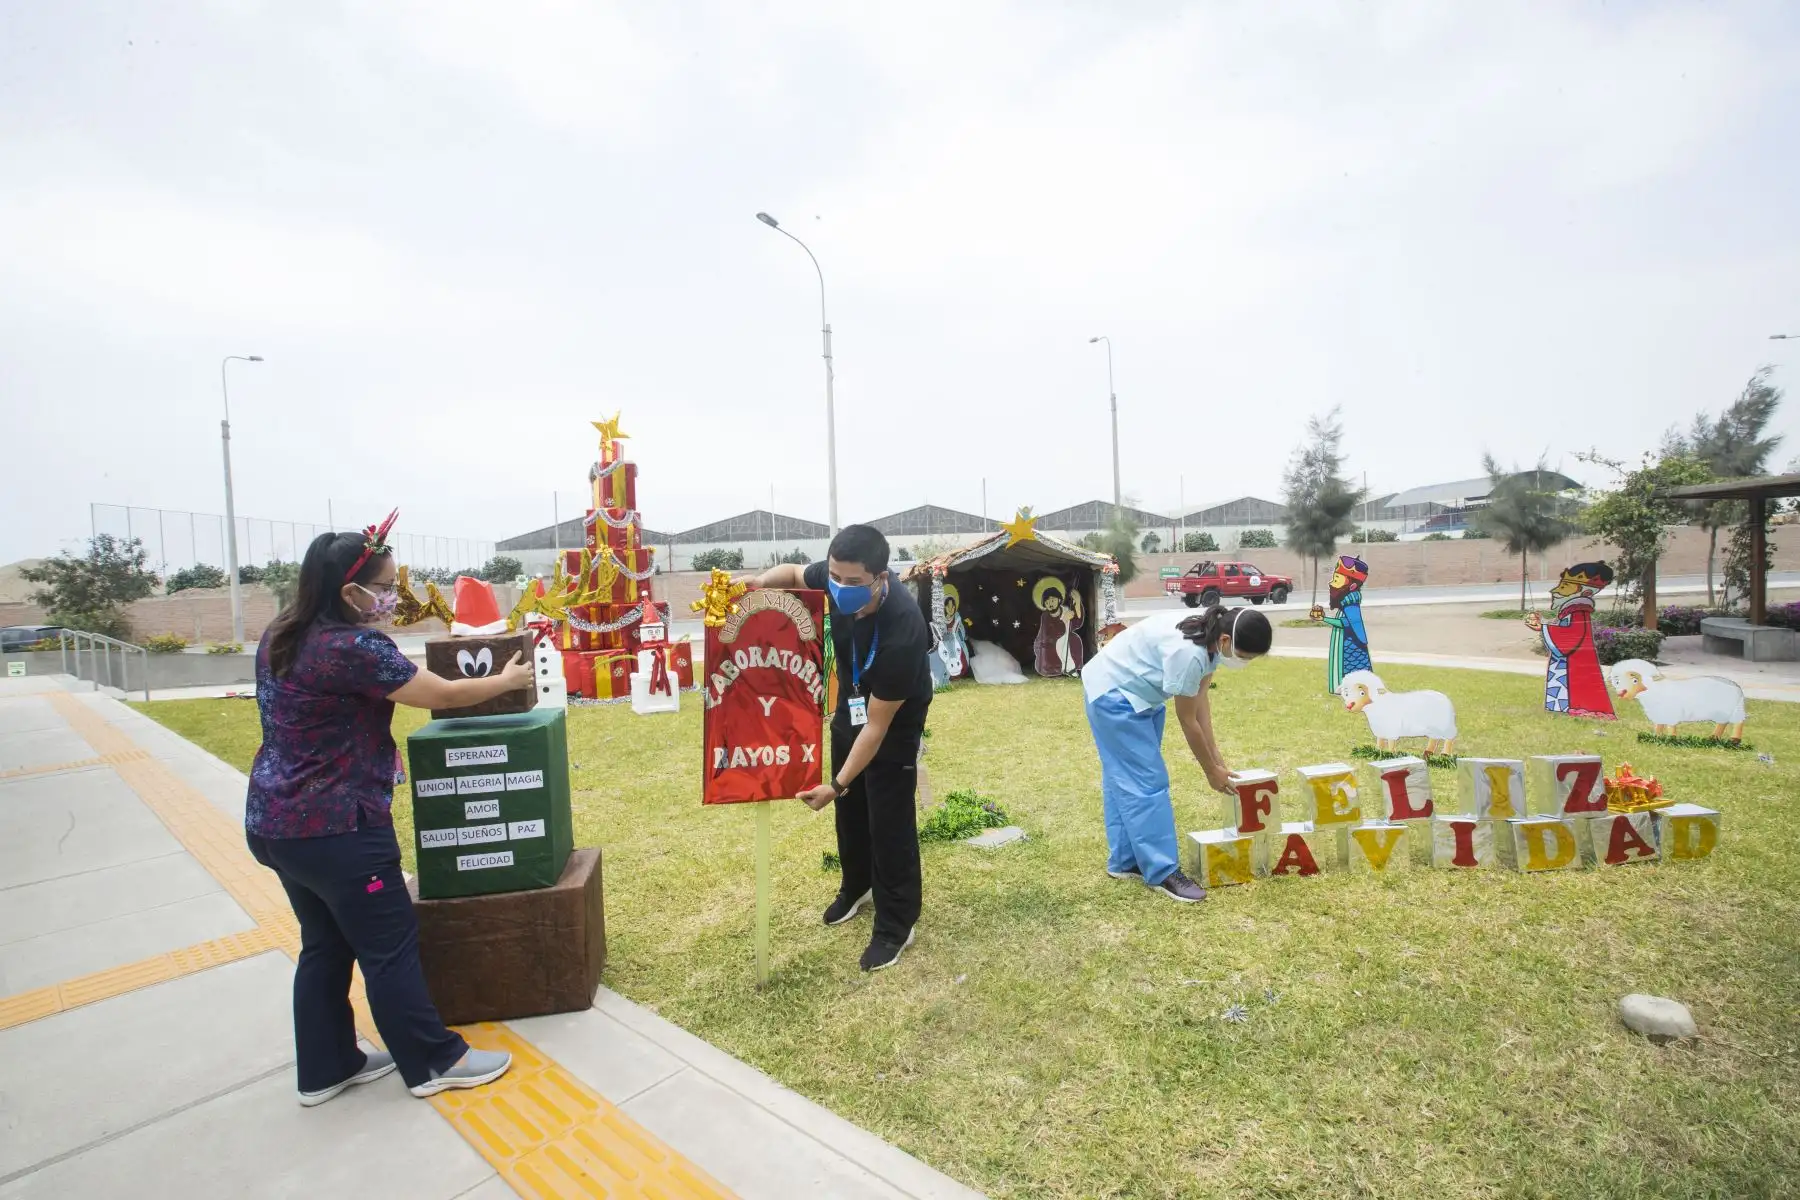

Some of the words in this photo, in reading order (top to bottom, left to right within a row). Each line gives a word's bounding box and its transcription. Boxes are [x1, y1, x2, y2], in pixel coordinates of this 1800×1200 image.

[723, 597, 755, 635] FELIZ
[763, 593, 812, 635] NAVIDAD
[702, 646, 825, 709] LABORATORIO
[758, 696, 777, 716] Y
[448, 749, 506, 761] ESPERANZA
[713, 745, 790, 769] RAYOS
[801, 743, 816, 763] X
[460, 778, 502, 789] ALEGRIA
[508, 774, 543, 785] MAGIA
[1235, 761, 1608, 834] FELIZ
[466, 804, 498, 814] AMOR
[422, 832, 455, 843] SALUD
[462, 827, 503, 840] SUEÑOS
[518, 824, 536, 834] PAZ
[1206, 815, 1718, 887] NAVIDAD
[460, 855, 511, 868] FELICIDAD
